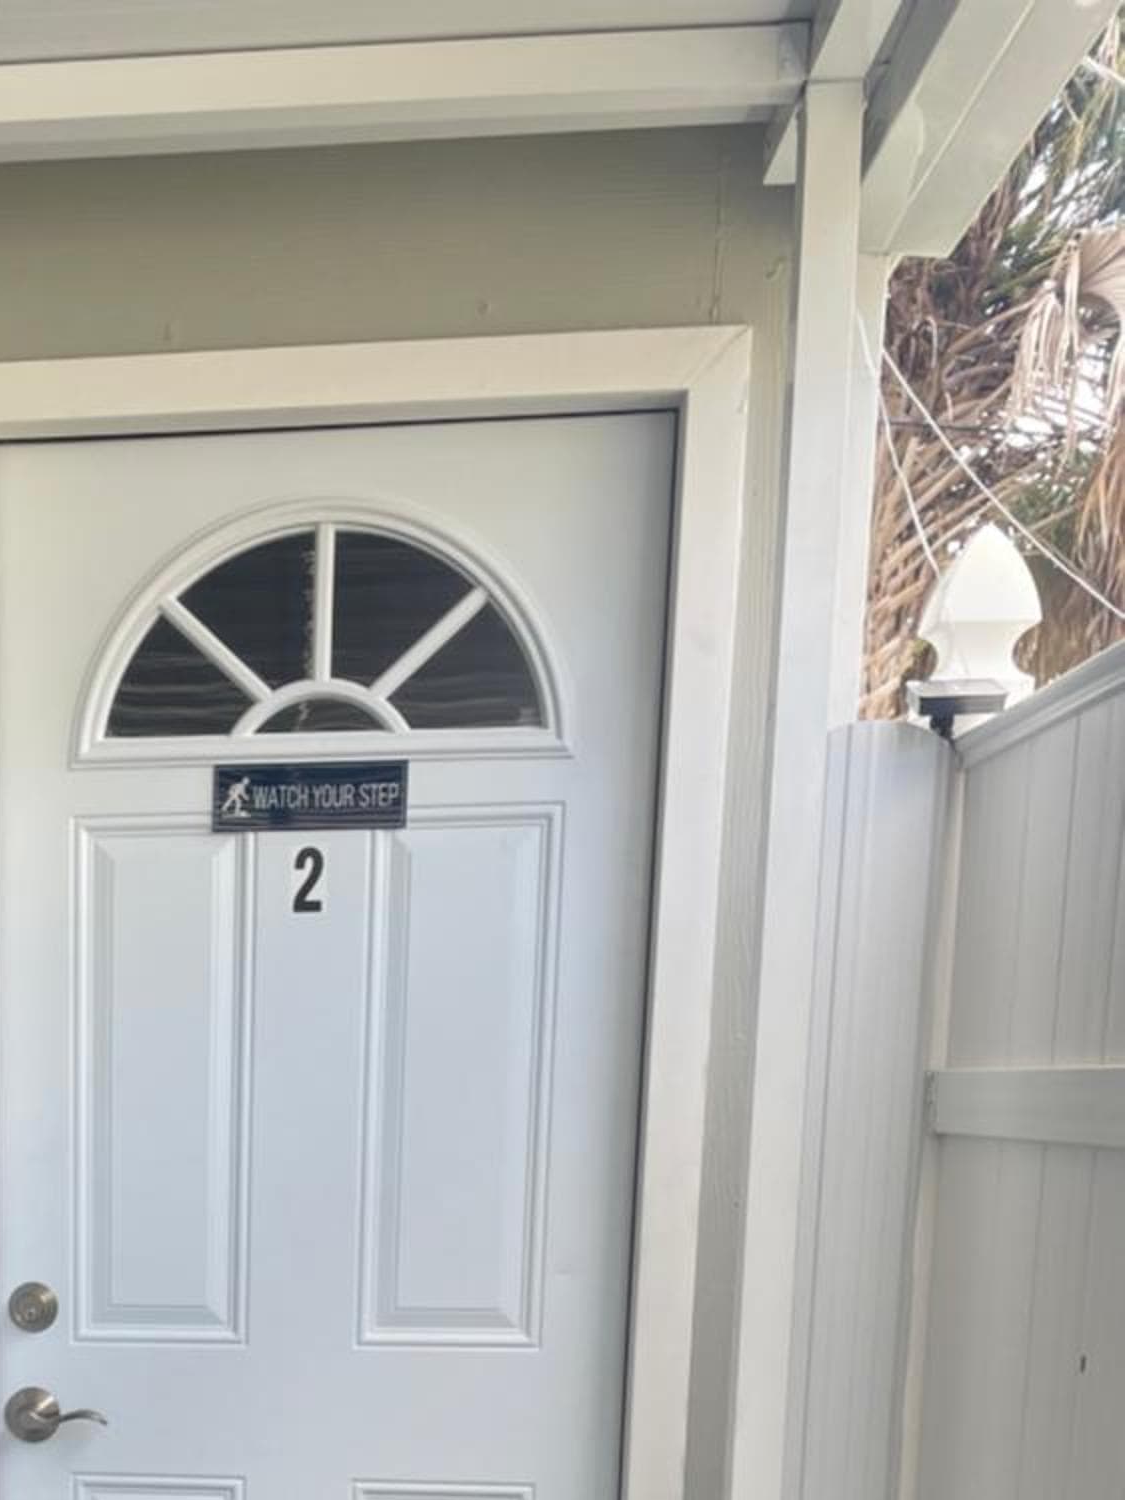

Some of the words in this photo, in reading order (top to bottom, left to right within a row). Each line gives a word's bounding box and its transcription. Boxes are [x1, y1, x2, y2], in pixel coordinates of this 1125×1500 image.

[252, 784, 309, 810] WATCH
[312, 783, 355, 808] YOUR
[359, 782, 399, 807] STEP
[292, 846, 324, 913] 2
